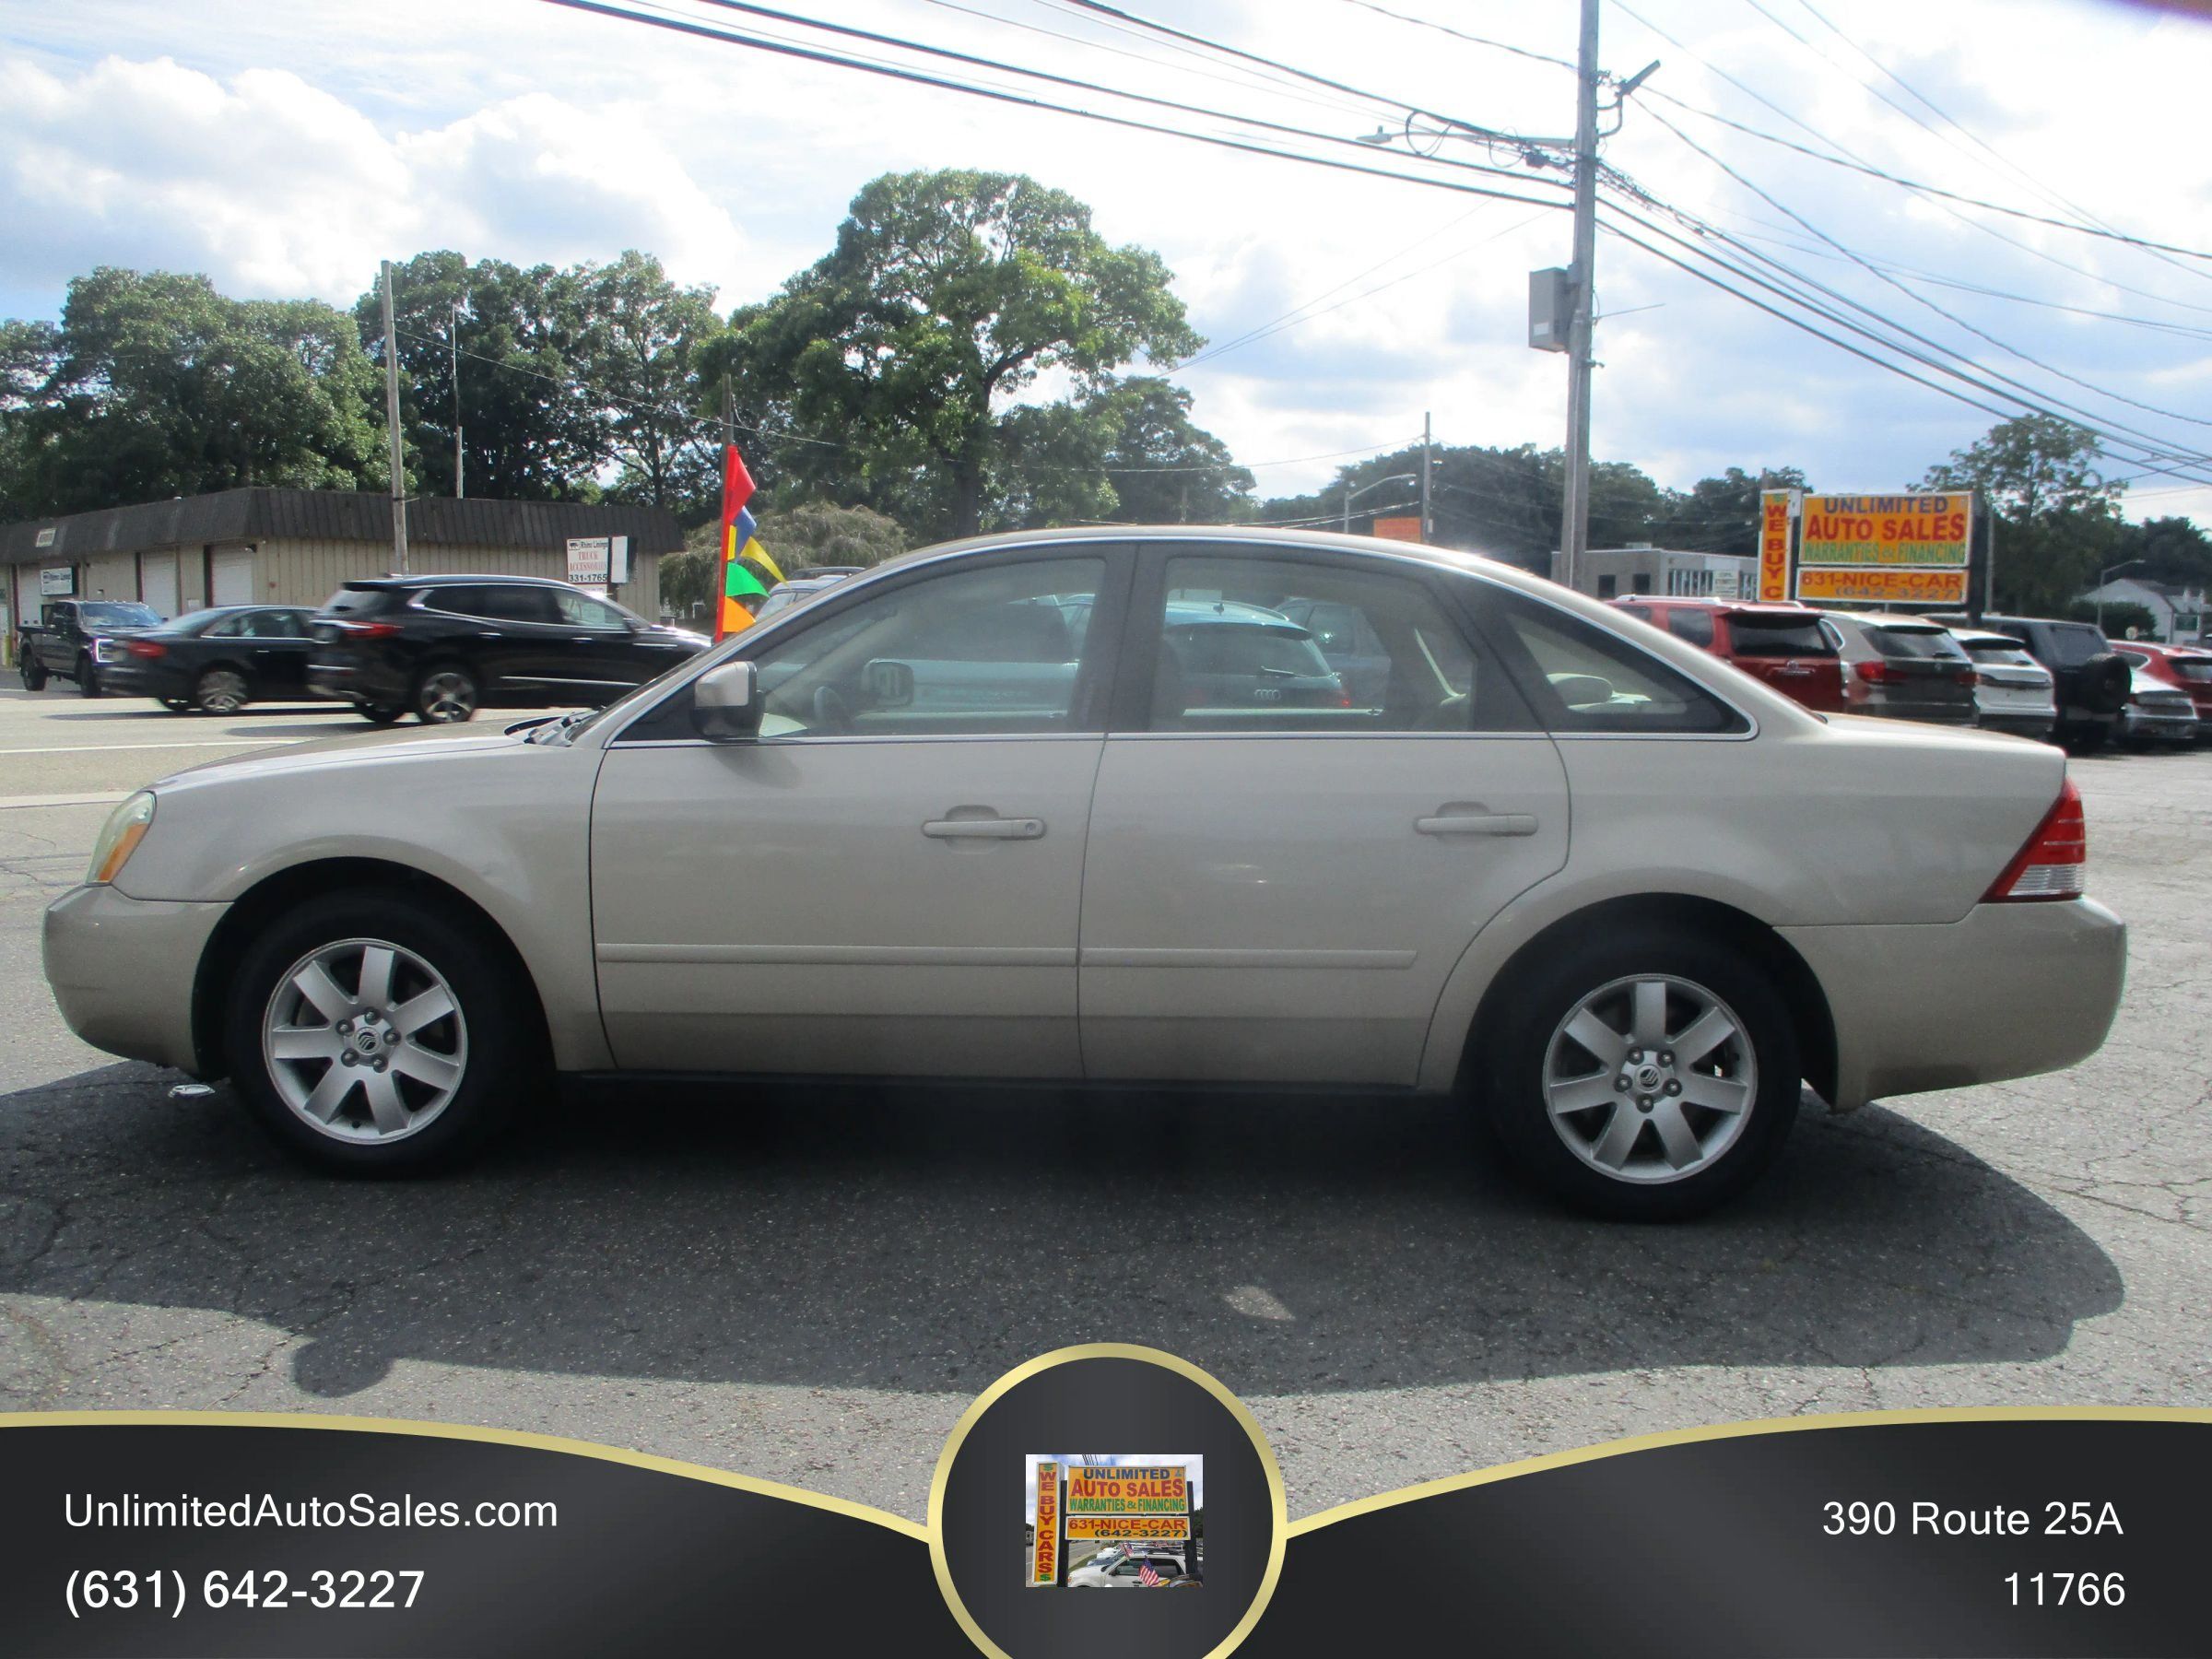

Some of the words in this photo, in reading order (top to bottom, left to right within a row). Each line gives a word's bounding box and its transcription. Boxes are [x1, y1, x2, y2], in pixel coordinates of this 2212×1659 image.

[1824, 496, 1948, 513] UNLIMITED
[1806, 514, 1874, 541] AUTO
[1882, 512, 1965, 542] SALES
[1766, 538, 1785, 580] BUY
[1804, 542, 1879, 561] WARRANTIES
[1898, 542, 1967, 563] FINANCING
[569, 573, 607, 582] 331-1765
[1801, 572, 1961, 587] 631-NICE-CAR
[1835, 586, 1963, 598] (642-3227)
